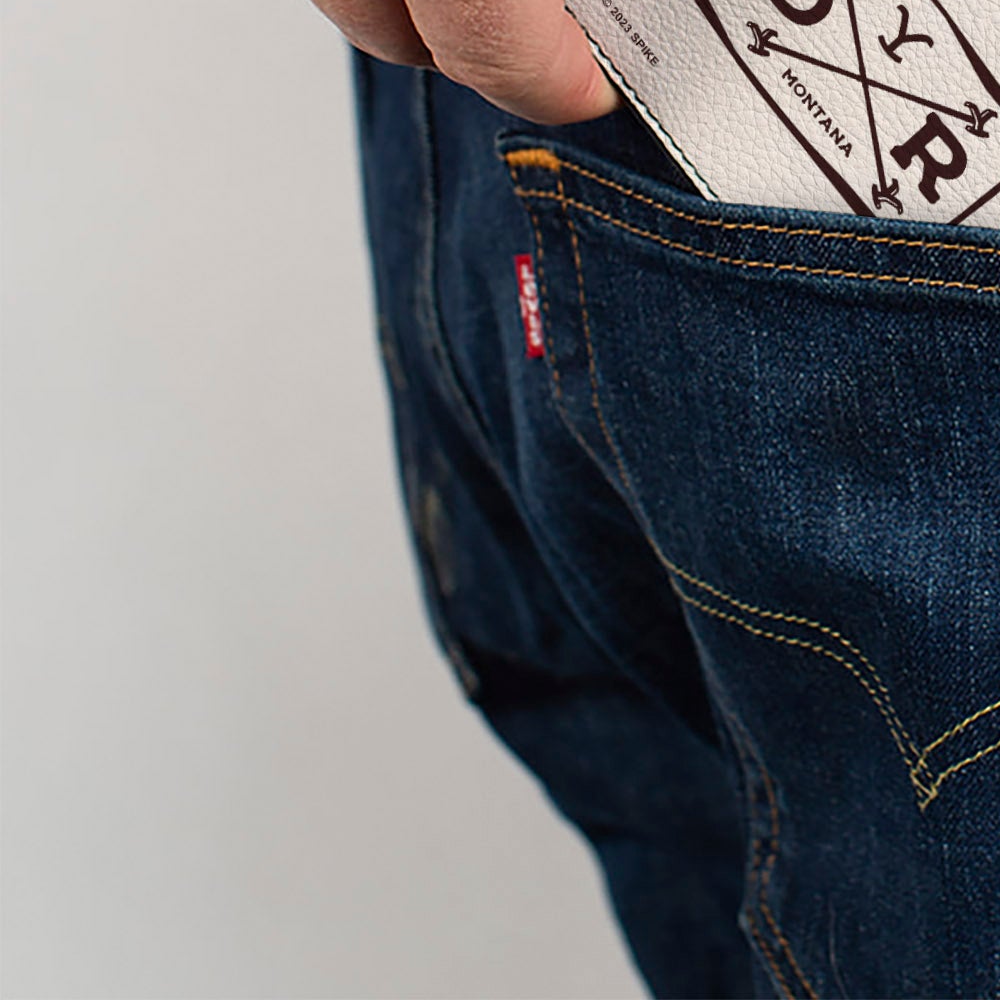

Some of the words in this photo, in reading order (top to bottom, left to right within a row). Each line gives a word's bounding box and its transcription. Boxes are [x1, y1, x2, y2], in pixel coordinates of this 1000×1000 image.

[610, 6, 633, 33] 2023
[630, 32, 660, 67] SPIKE
[781, 67, 853, 158] MONTANA
[890, 111, 968, 204] R
